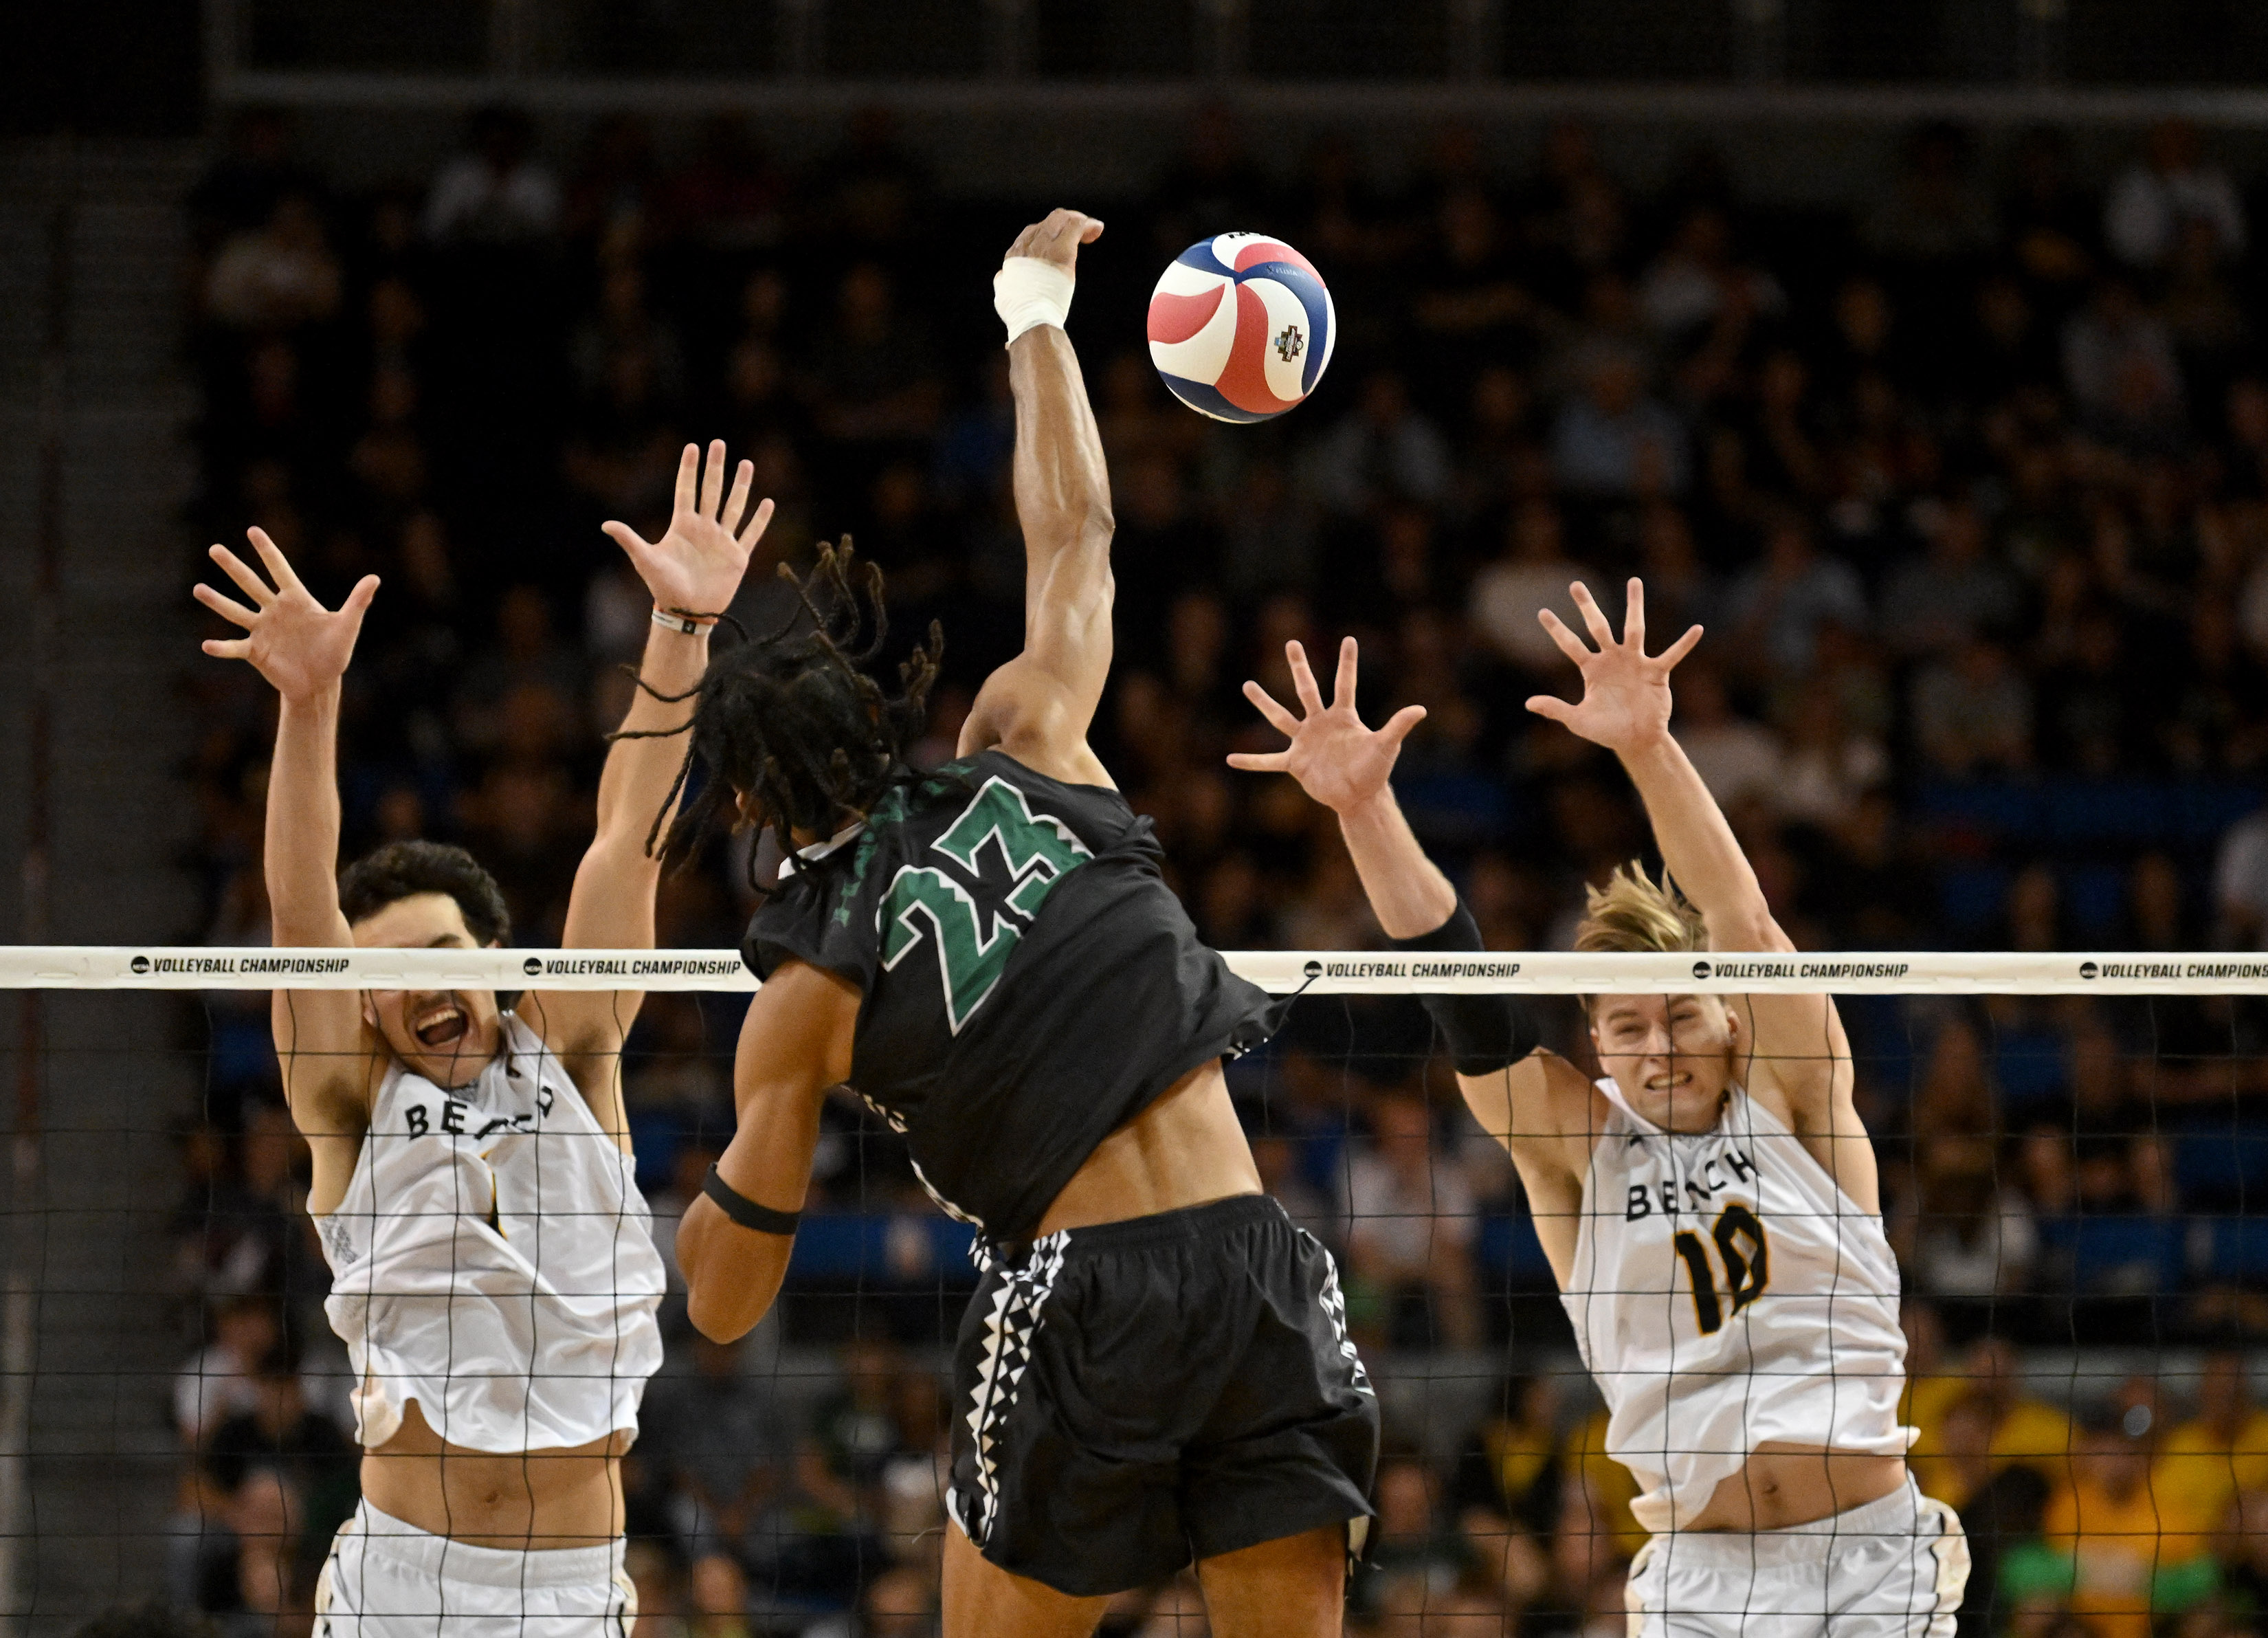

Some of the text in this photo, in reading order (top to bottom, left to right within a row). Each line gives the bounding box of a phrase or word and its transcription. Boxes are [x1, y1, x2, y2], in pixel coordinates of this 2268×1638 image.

[875, 775, 1096, 1037] 23
[153, 958, 234, 973] VOLLEYBALL
[240, 958, 349, 973] CHAMPIONSHIP
[546, 960, 627, 974] VOLLEYBALL
[632, 960, 741, 974] CHAMPIONSHIP
[1326, 963, 1406, 977] VOLLEYBALL
[1412, 963, 1520, 977] CHAMPIONSHIP
[1716, 964, 1795, 977] VOLLEYBALL
[1801, 964, 1909, 977] CHAMPIONSHIP
[2102, 964, 2181, 977] VOLLEYBALL
[1626, 1151, 1761, 1221] BEACH
[1672, 1200, 1770, 1338] 10
